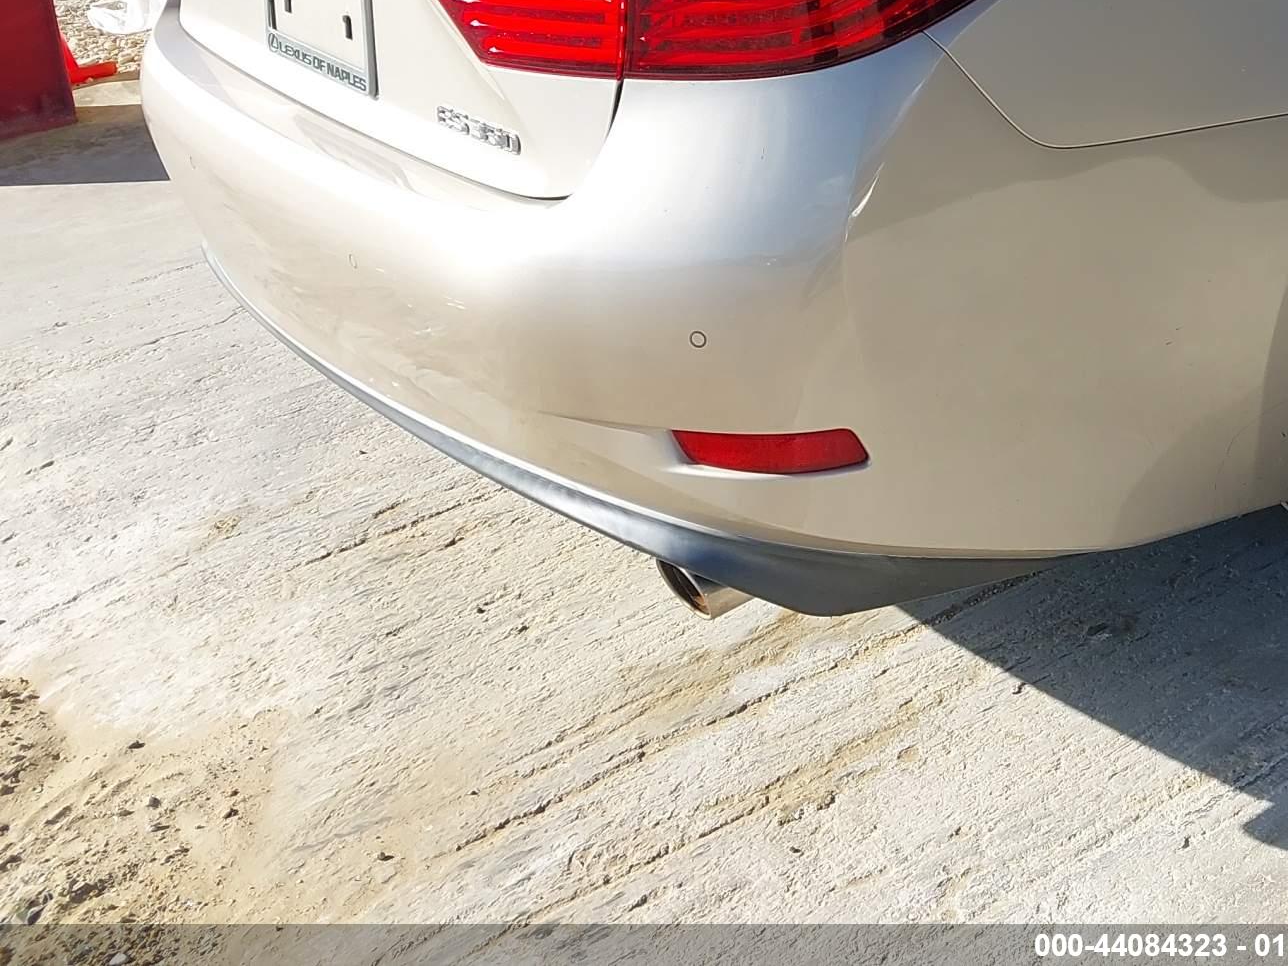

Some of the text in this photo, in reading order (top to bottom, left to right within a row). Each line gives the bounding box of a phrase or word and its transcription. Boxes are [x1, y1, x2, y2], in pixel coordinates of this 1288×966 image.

[279, 41, 367, 92] LEXUS OF NAPLES
